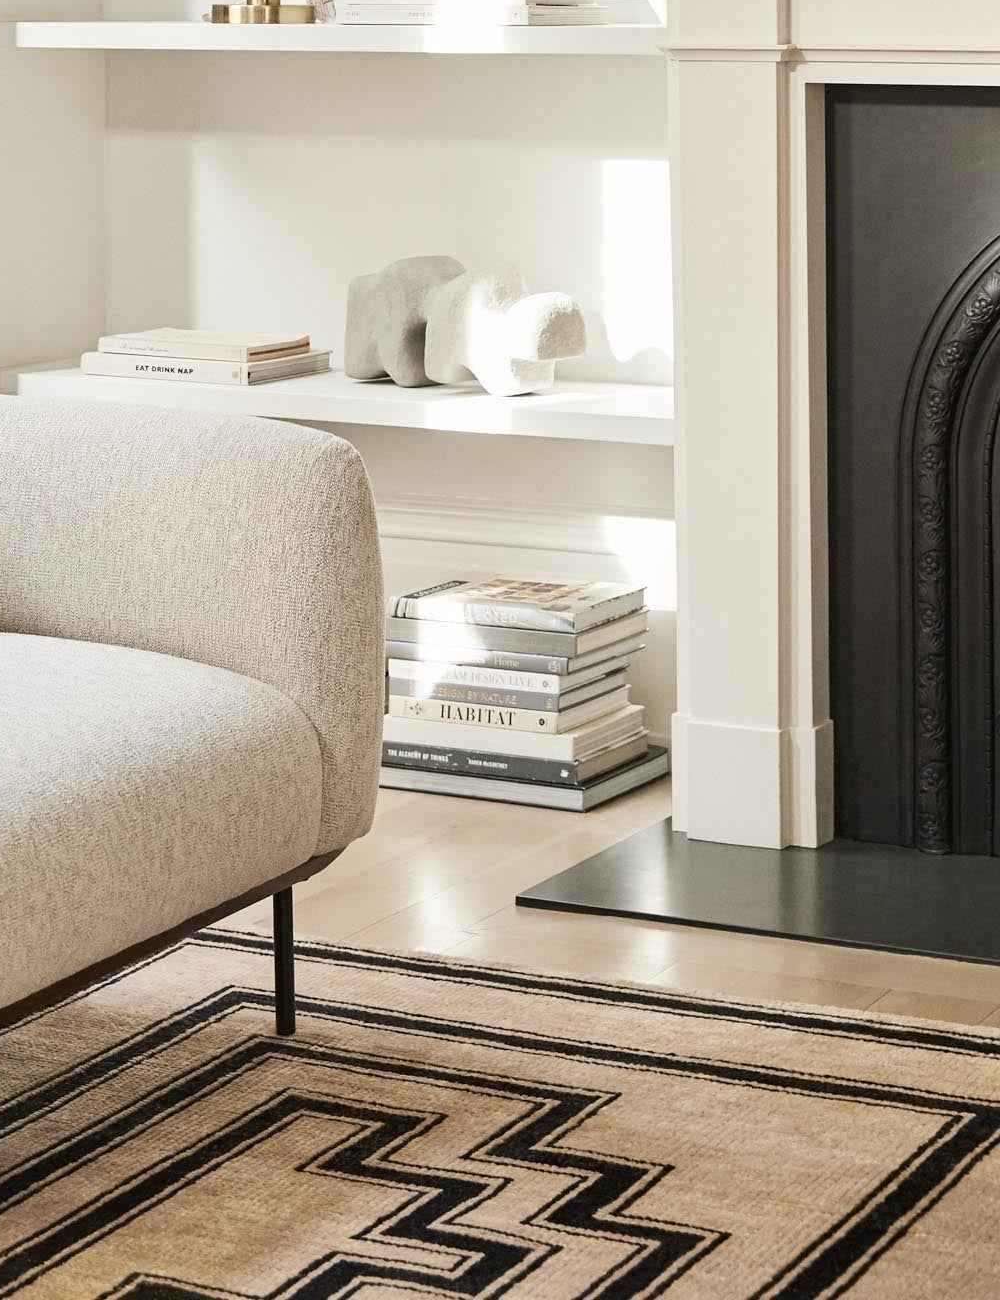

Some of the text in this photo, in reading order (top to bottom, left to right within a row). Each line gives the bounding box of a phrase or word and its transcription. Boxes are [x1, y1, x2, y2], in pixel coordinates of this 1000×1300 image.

[151, 365, 175, 373] DRINK
[177, 367, 194, 375] NAP
[438, 703, 518, 726] HABITAT
